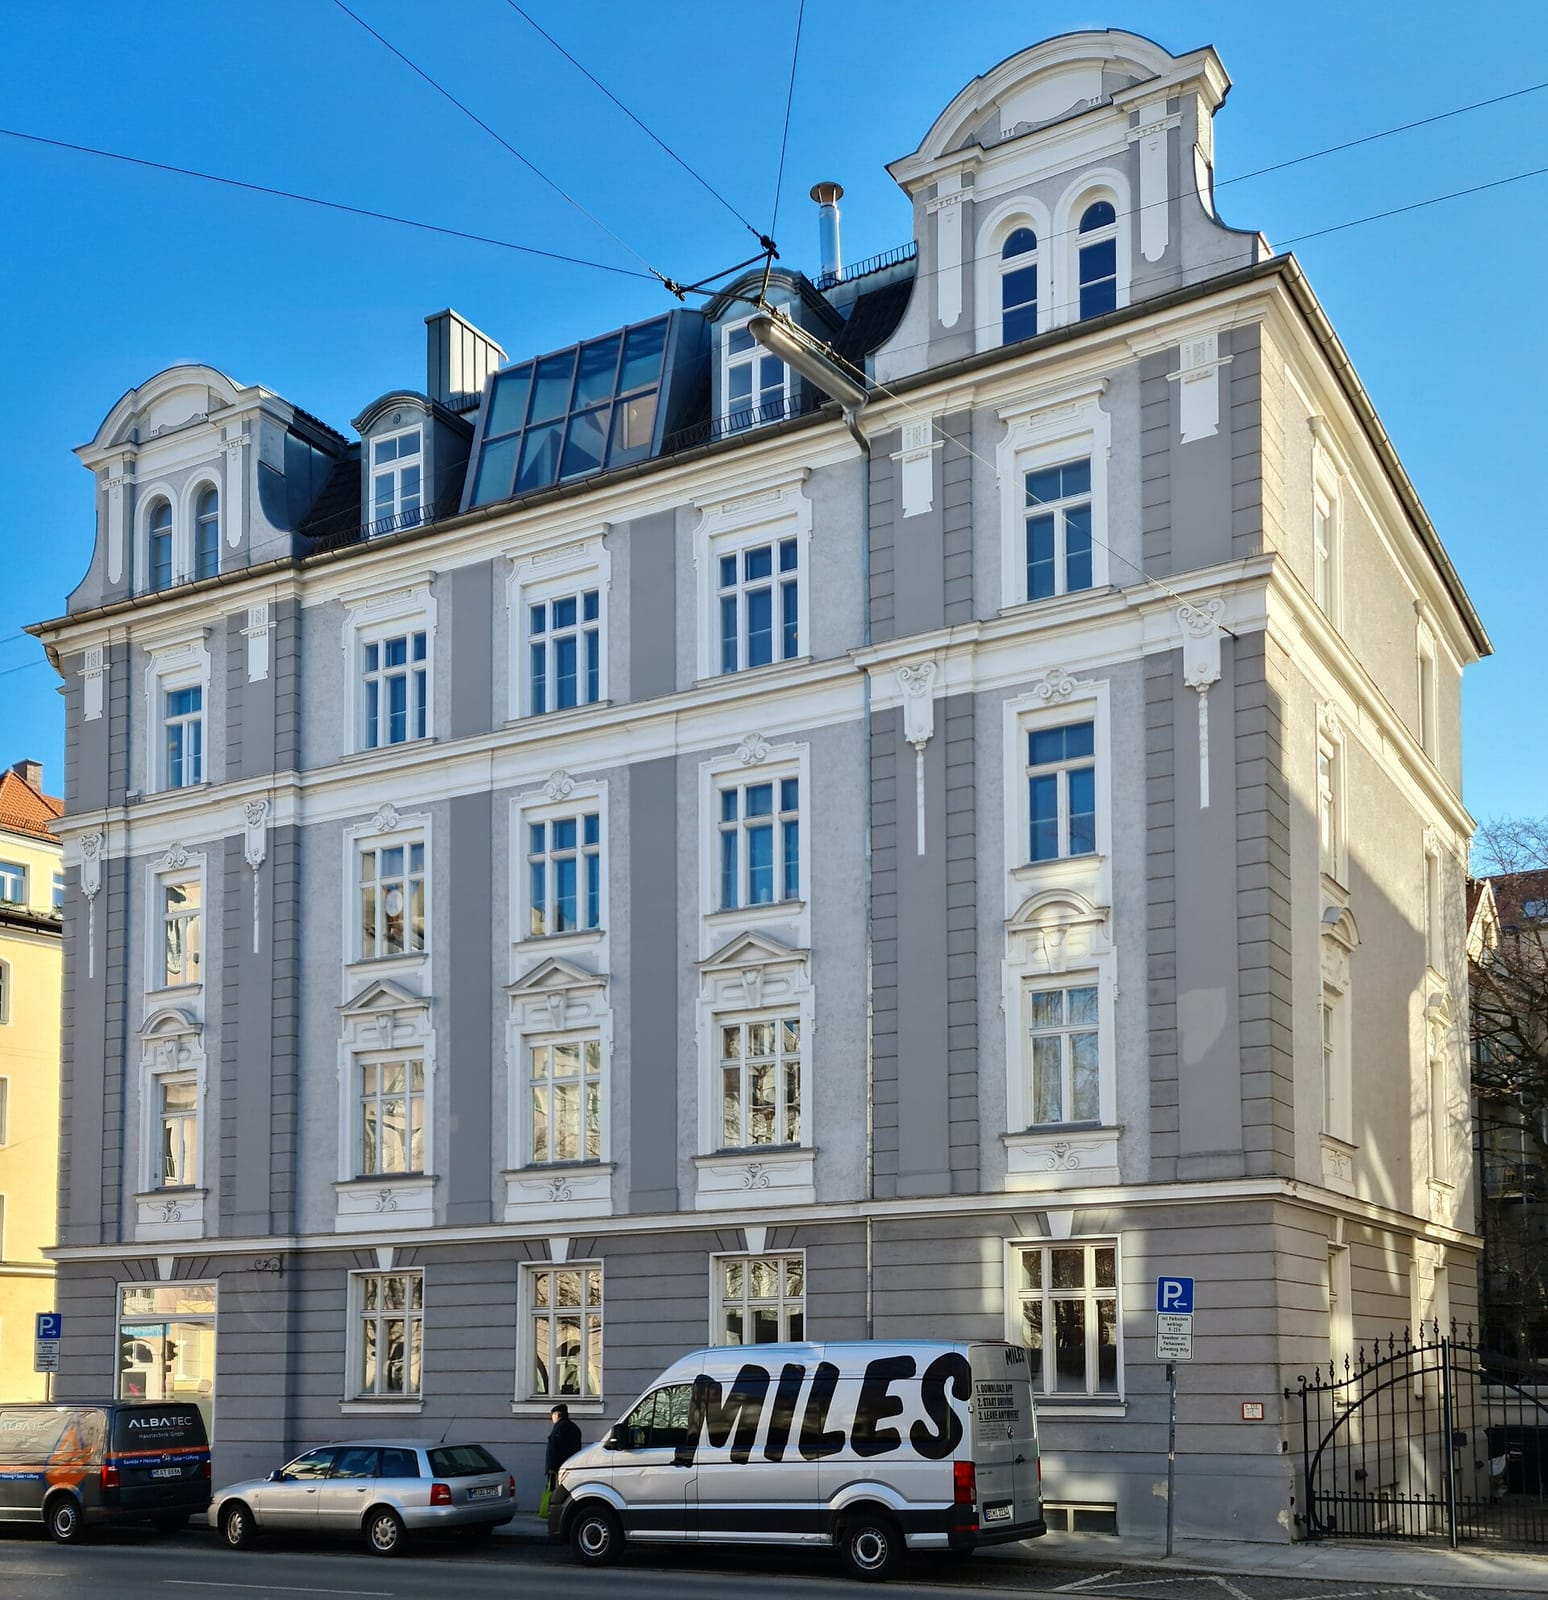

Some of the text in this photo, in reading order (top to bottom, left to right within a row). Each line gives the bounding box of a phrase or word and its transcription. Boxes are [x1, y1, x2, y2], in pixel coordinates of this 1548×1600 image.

[1163, 1281, 1183, 1309] P
[40, 1317, 54, 1336] P
[981, 1384, 1005, 1393] DOWNLOAD
[977, 1398, 983, 1407] 2.
[983, 1398, 997, 1407] START
[675, 1352, 972, 1467] MILES
[984, 1411, 999, 1420] LEAVE
[128, 1416, 193, 1428] ALBATEC
